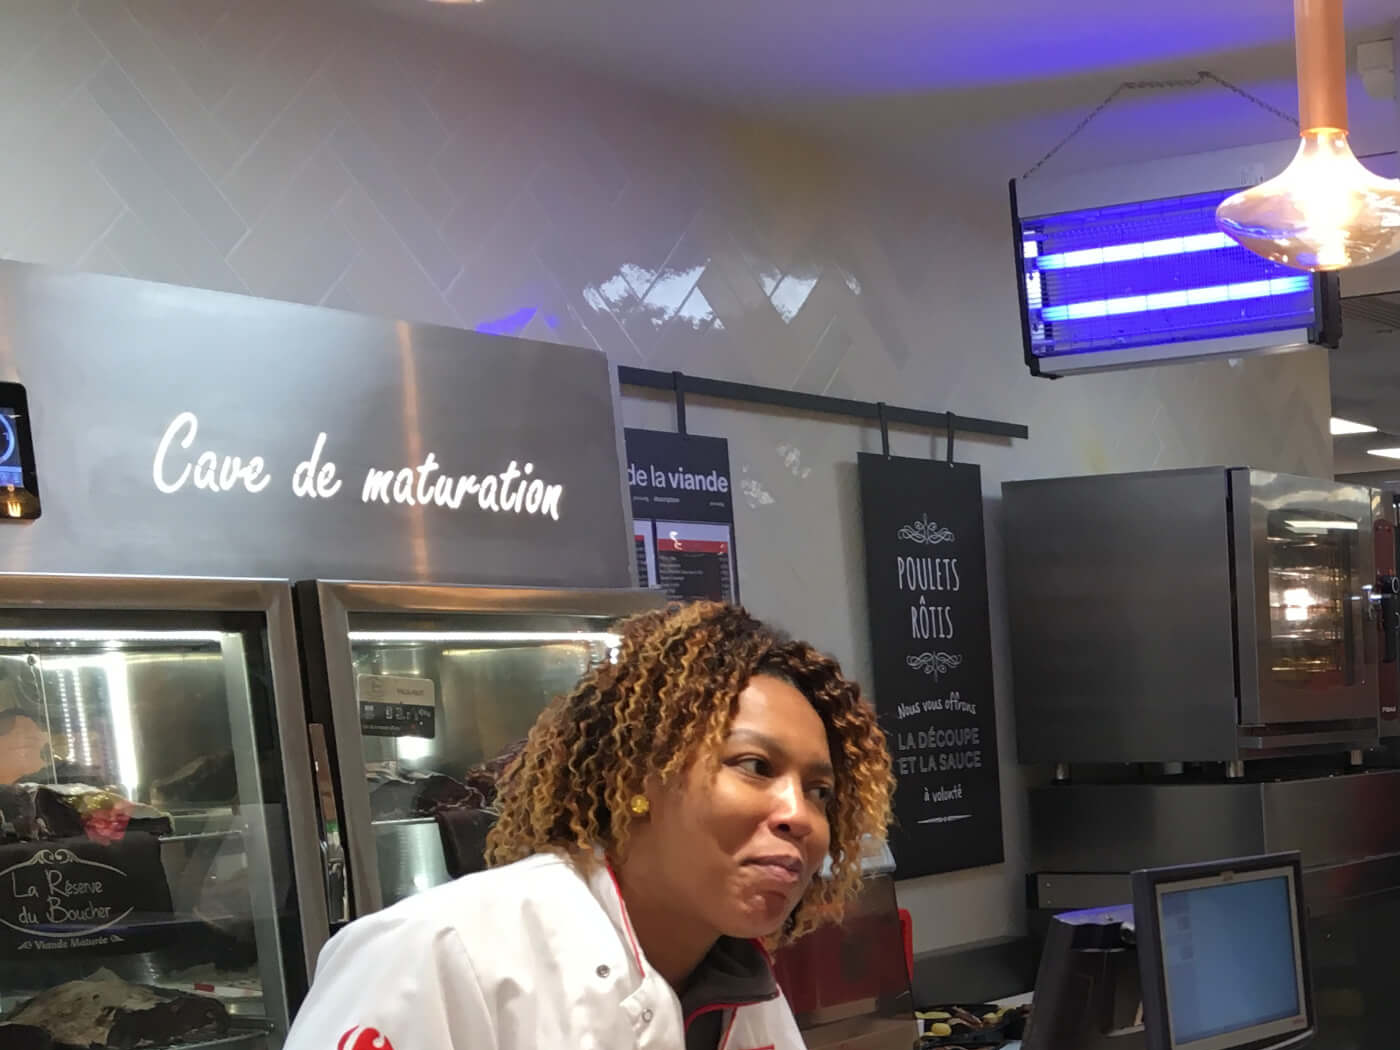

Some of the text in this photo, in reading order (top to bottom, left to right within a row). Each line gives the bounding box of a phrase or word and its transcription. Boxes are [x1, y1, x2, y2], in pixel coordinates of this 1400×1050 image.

[153, 411, 564, 521] Cave de maturation
[627, 464, 728, 493] de la viande
[897, 556, 960, 591] POULETS
[911, 595, 954, 639] RÔTIS
[898, 691, 976, 719] Nous vous offrons
[898, 725, 980, 750] LA DÉCOUPE
[898, 751, 982, 775] ET LA SAUCE
[11, 871, 39, 898] La
[18, 896, 111, 925] du Boucher
